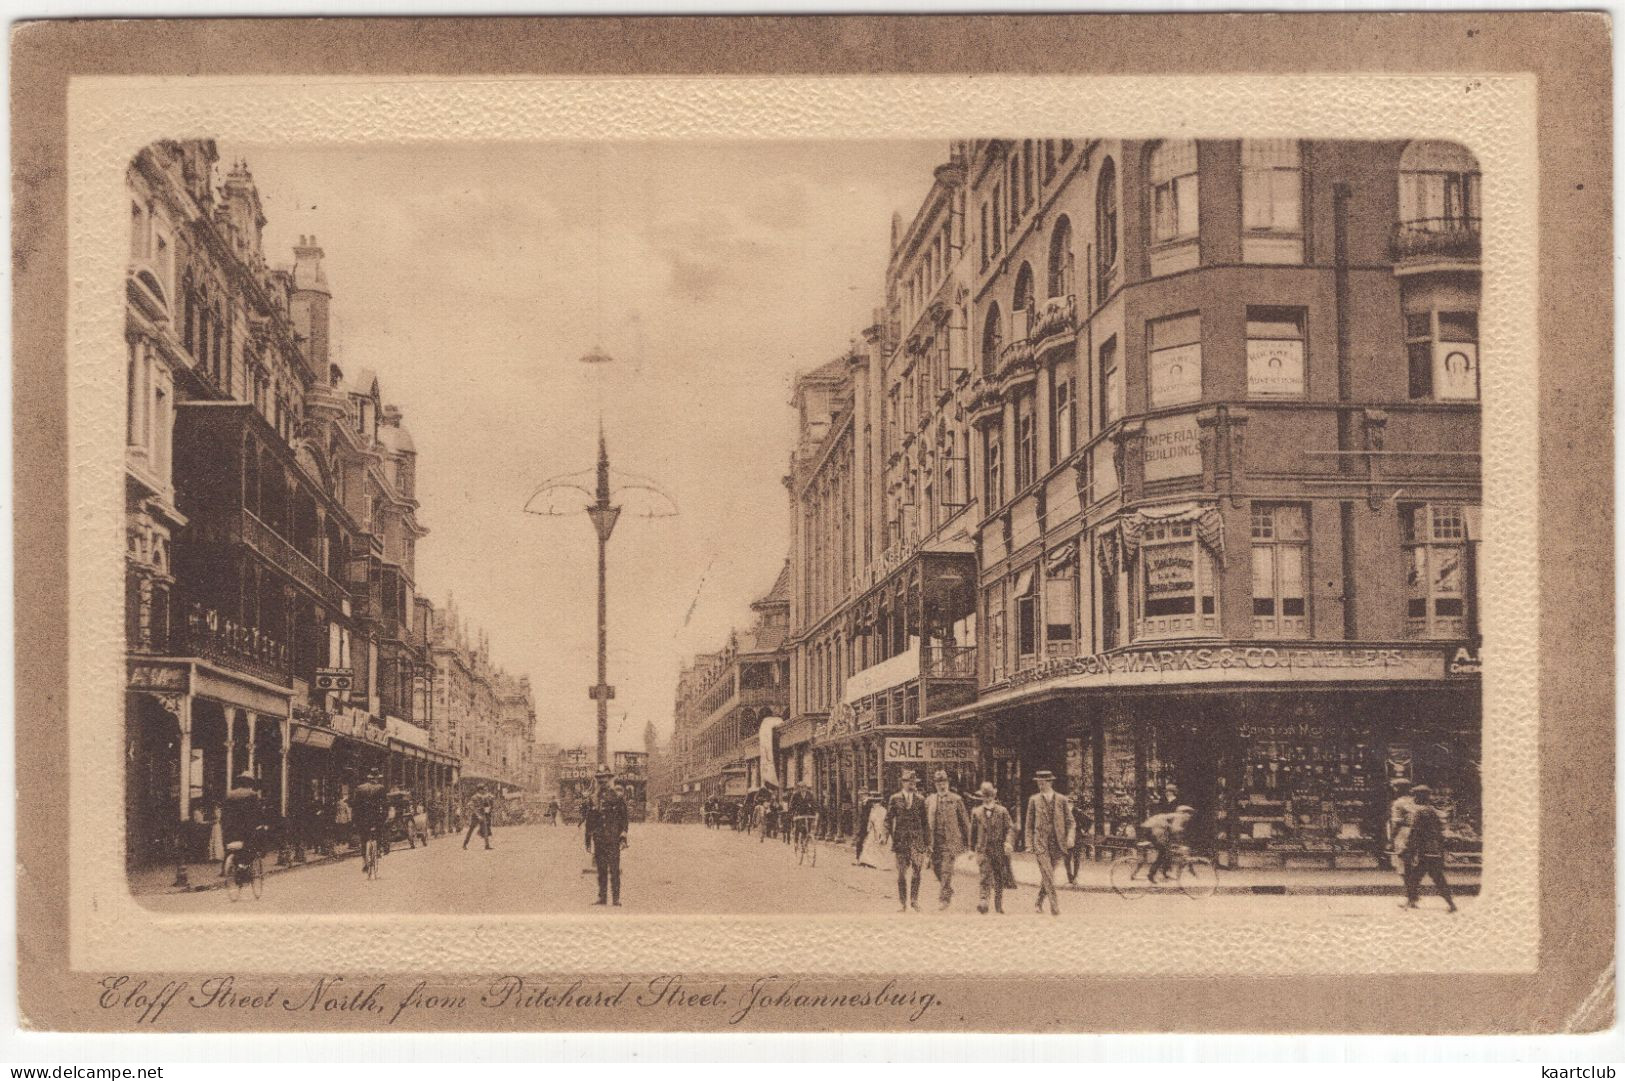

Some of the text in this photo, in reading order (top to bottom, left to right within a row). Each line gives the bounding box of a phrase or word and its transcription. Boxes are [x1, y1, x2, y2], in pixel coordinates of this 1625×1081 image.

[1144, 429, 1201, 448] IMPERIAL
[1144, 444, 1201, 461] BUILDINGS
[1122, 649, 1216, 673] MARKS
[1220, 649, 1235, 668] &
[888, 740, 923, 758] SALE
[930, 748, 968, 759] LINENS
